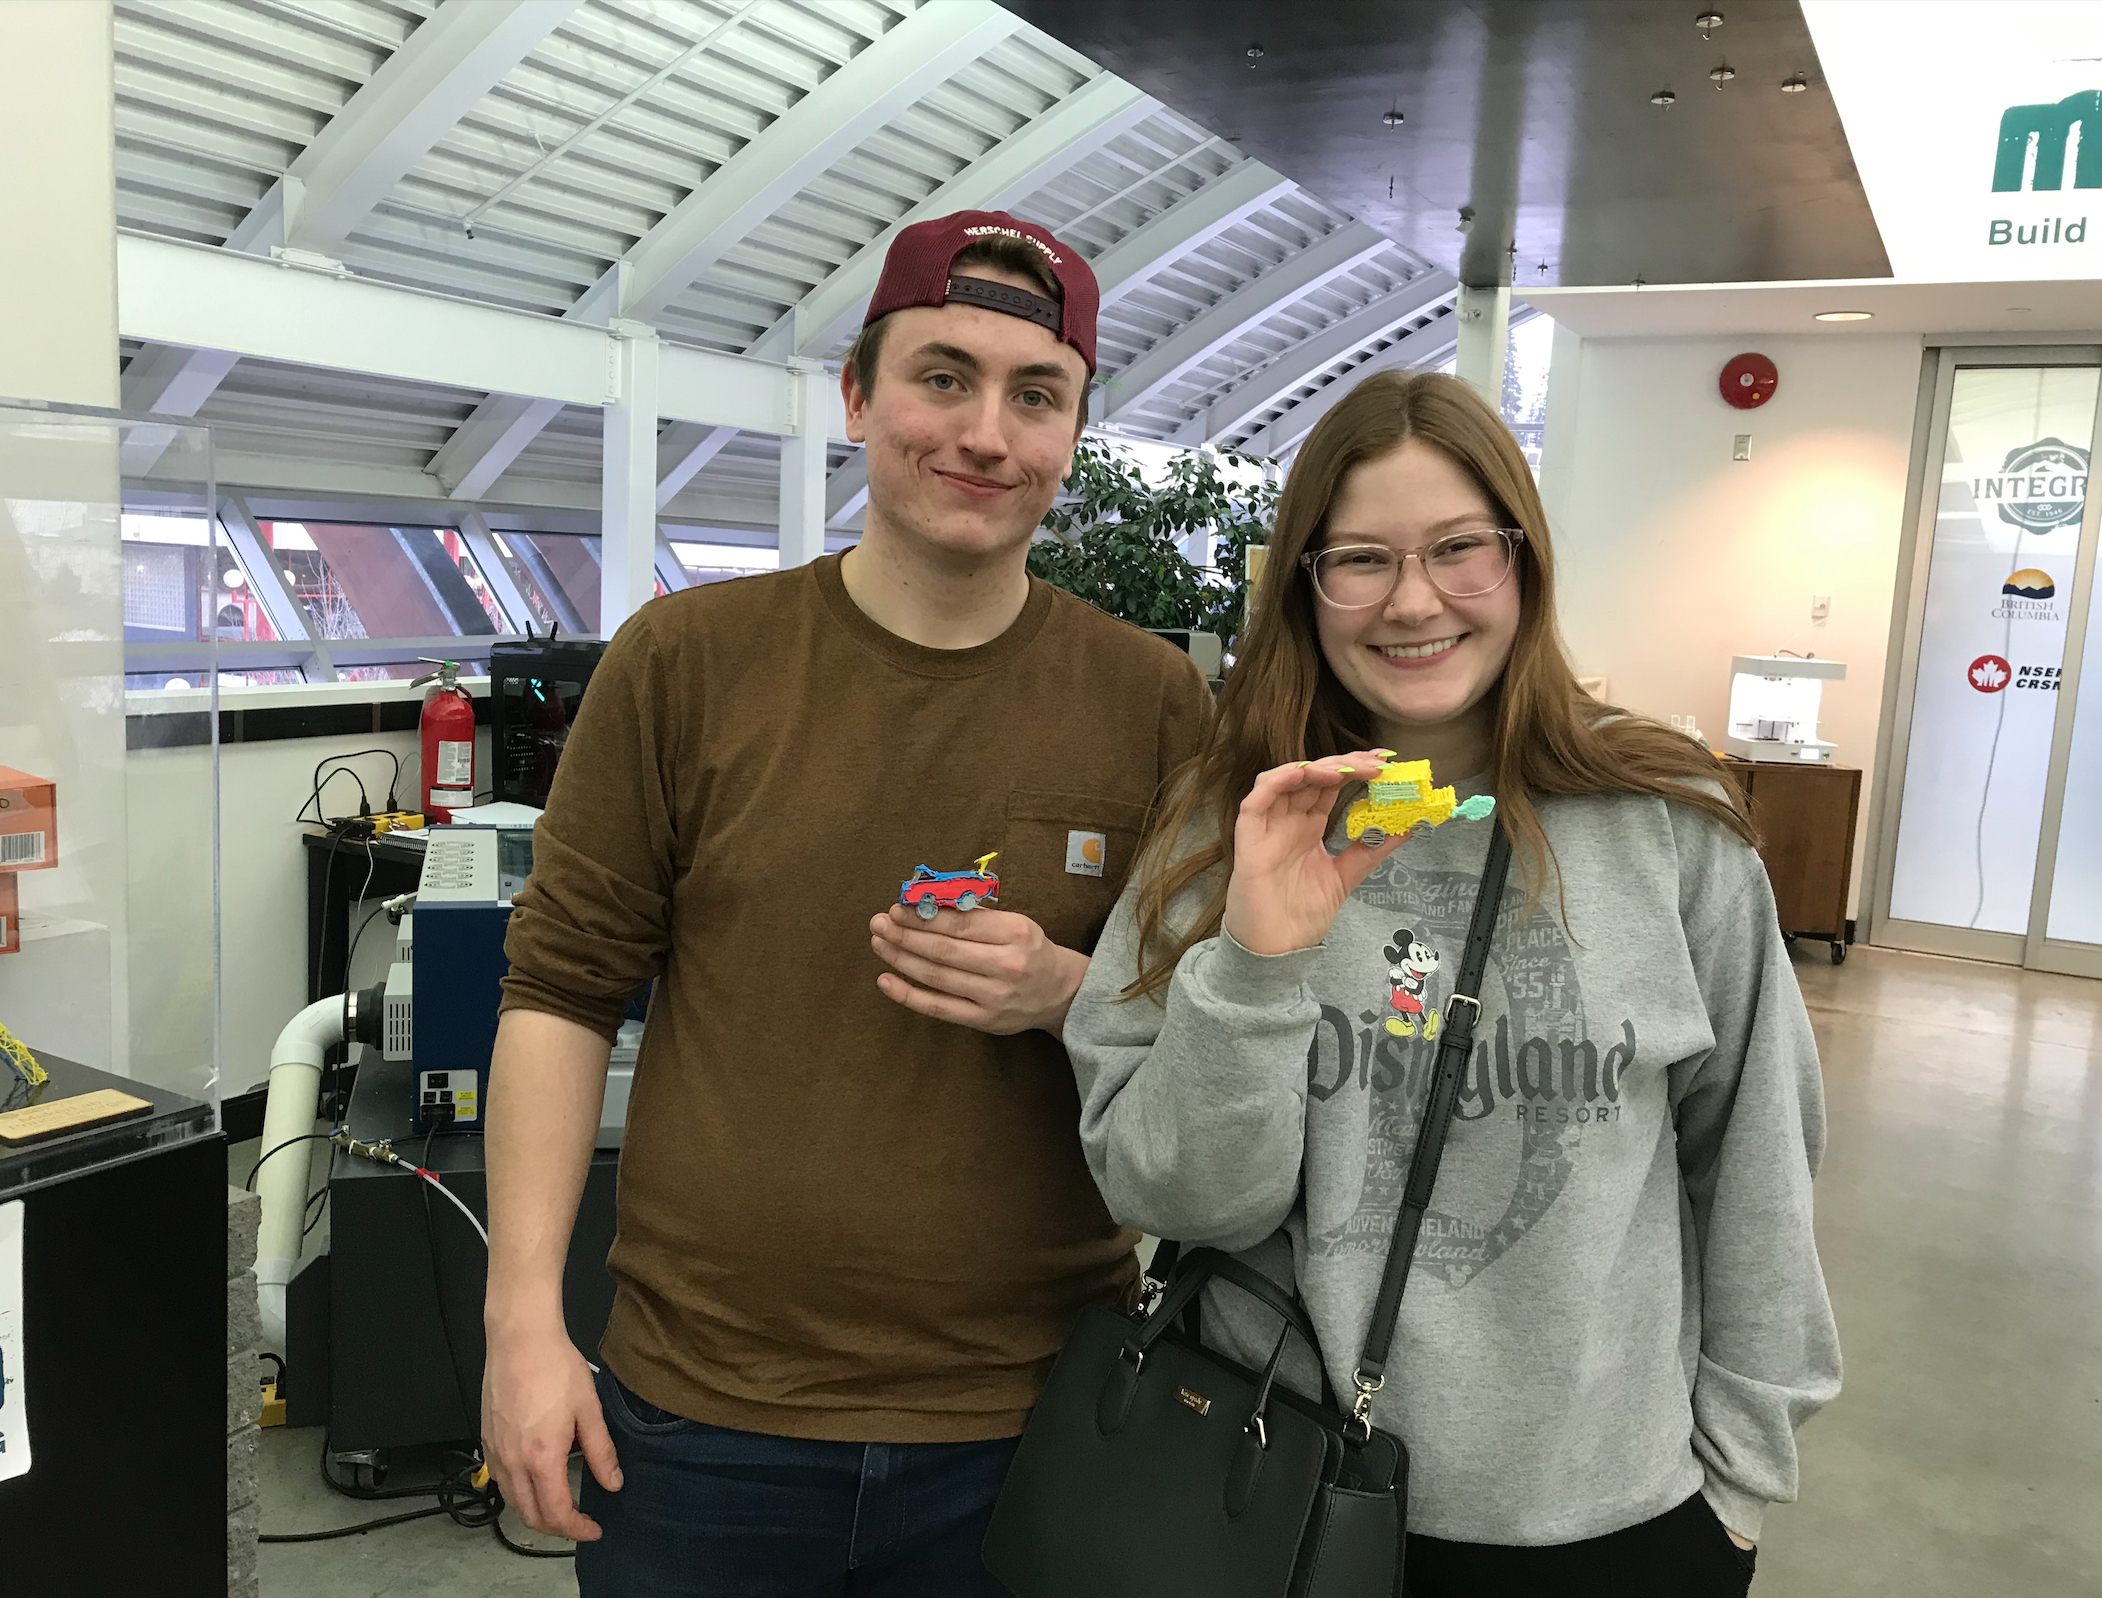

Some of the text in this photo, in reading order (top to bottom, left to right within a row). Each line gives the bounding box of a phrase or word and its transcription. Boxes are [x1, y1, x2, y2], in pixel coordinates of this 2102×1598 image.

[1988, 216, 2087, 245] Build
[964, 225, 1063, 265] HERSCHEL SUPPLY
[1991, 608, 2060, 621] COLUMBIA
[2001, 599, 2053, 611] BRITISH
[1506, 927, 1565, 951] PLACE
[1307, 1003, 1637, 1122] Disnyland
[1516, 1104, 1622, 1126] RESORT
[1368, 1137, 1414, 1157] STREE
